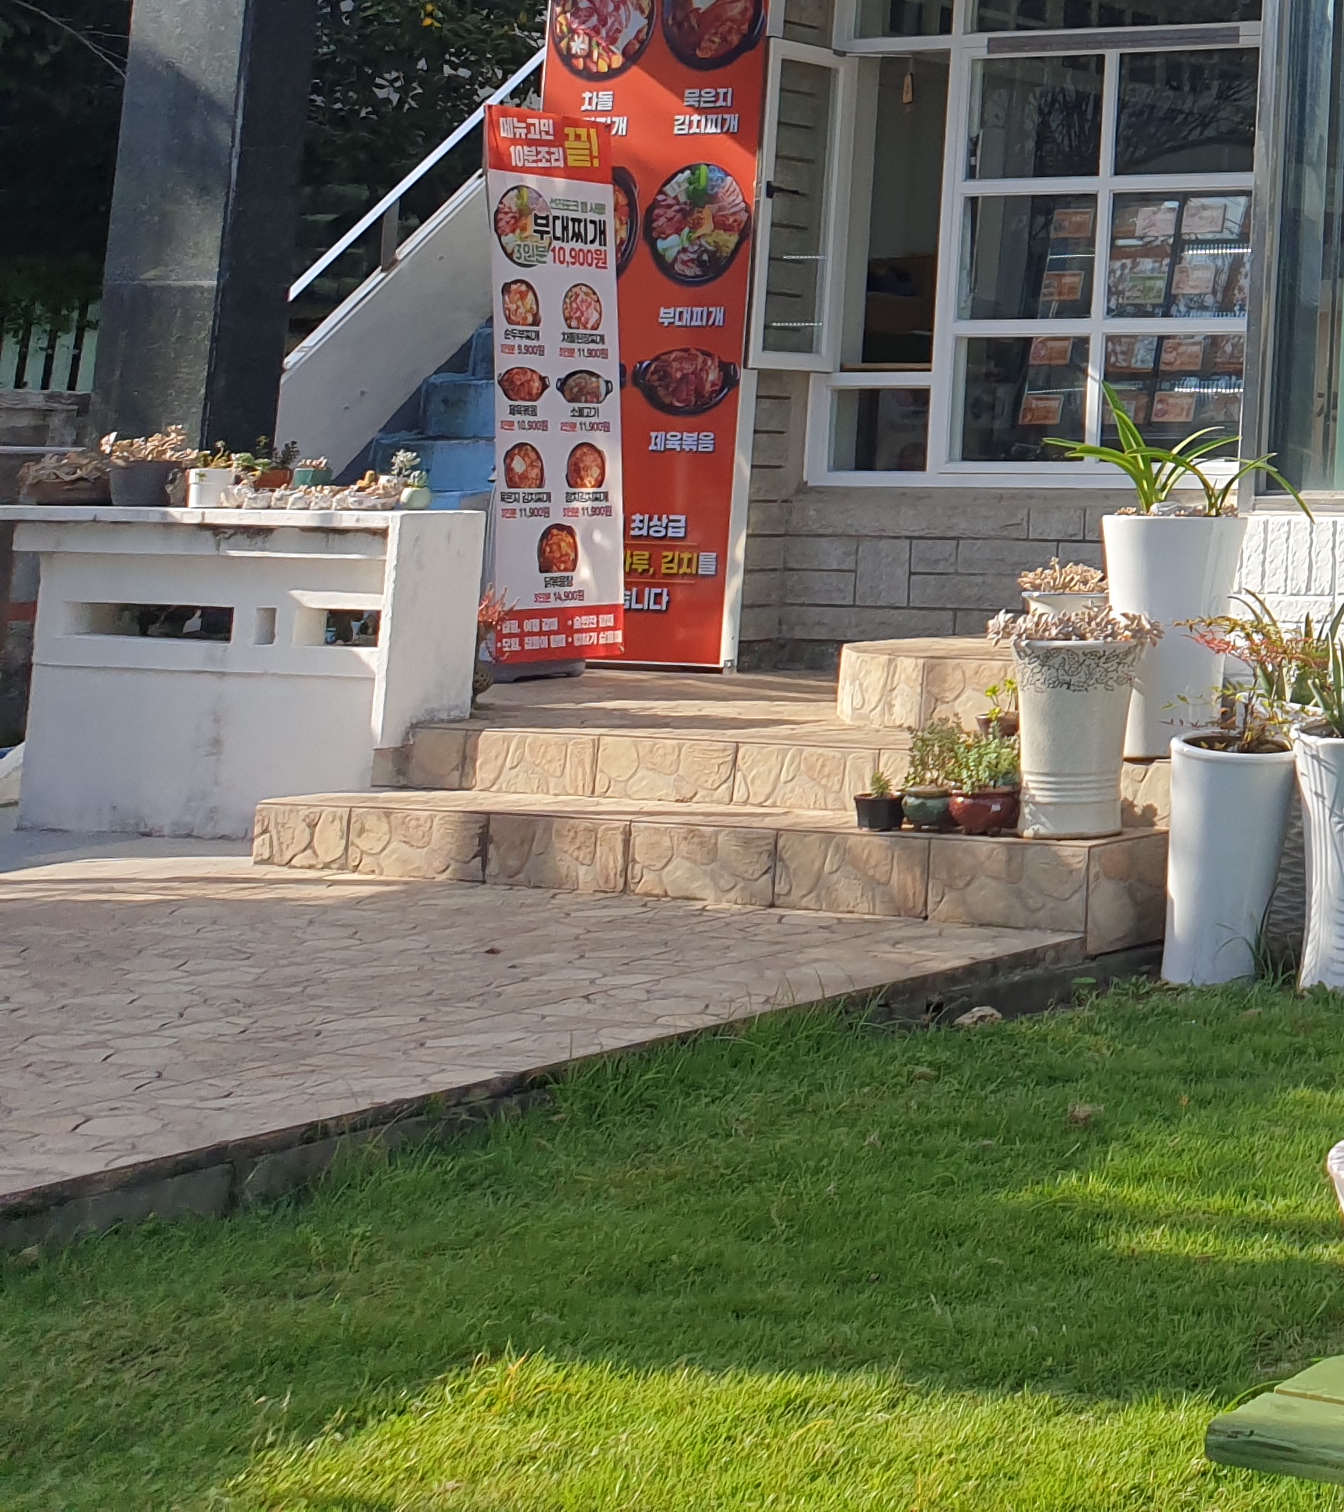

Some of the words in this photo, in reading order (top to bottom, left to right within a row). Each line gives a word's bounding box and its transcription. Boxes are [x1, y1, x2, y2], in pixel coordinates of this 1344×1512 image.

[581, 90, 614, 111] 차돌
[683, 88, 733, 107] 묵은지
[500, 117, 554, 140] 메뉴고민
[673, 114, 739, 135] 김치찌개
[564, 127, 600, 168] 끝!
[533, 212, 607, 248] 부대찌개
[514, 243, 547, 265] 3인분
[550, 245, 608, 270] 10,900원
[658, 307, 724, 327] 부대찌개
[649, 431, 714, 452] 제육볶음
[630, 513, 687, 537] 최상급
[661, 551, 717, 575] 김치를
